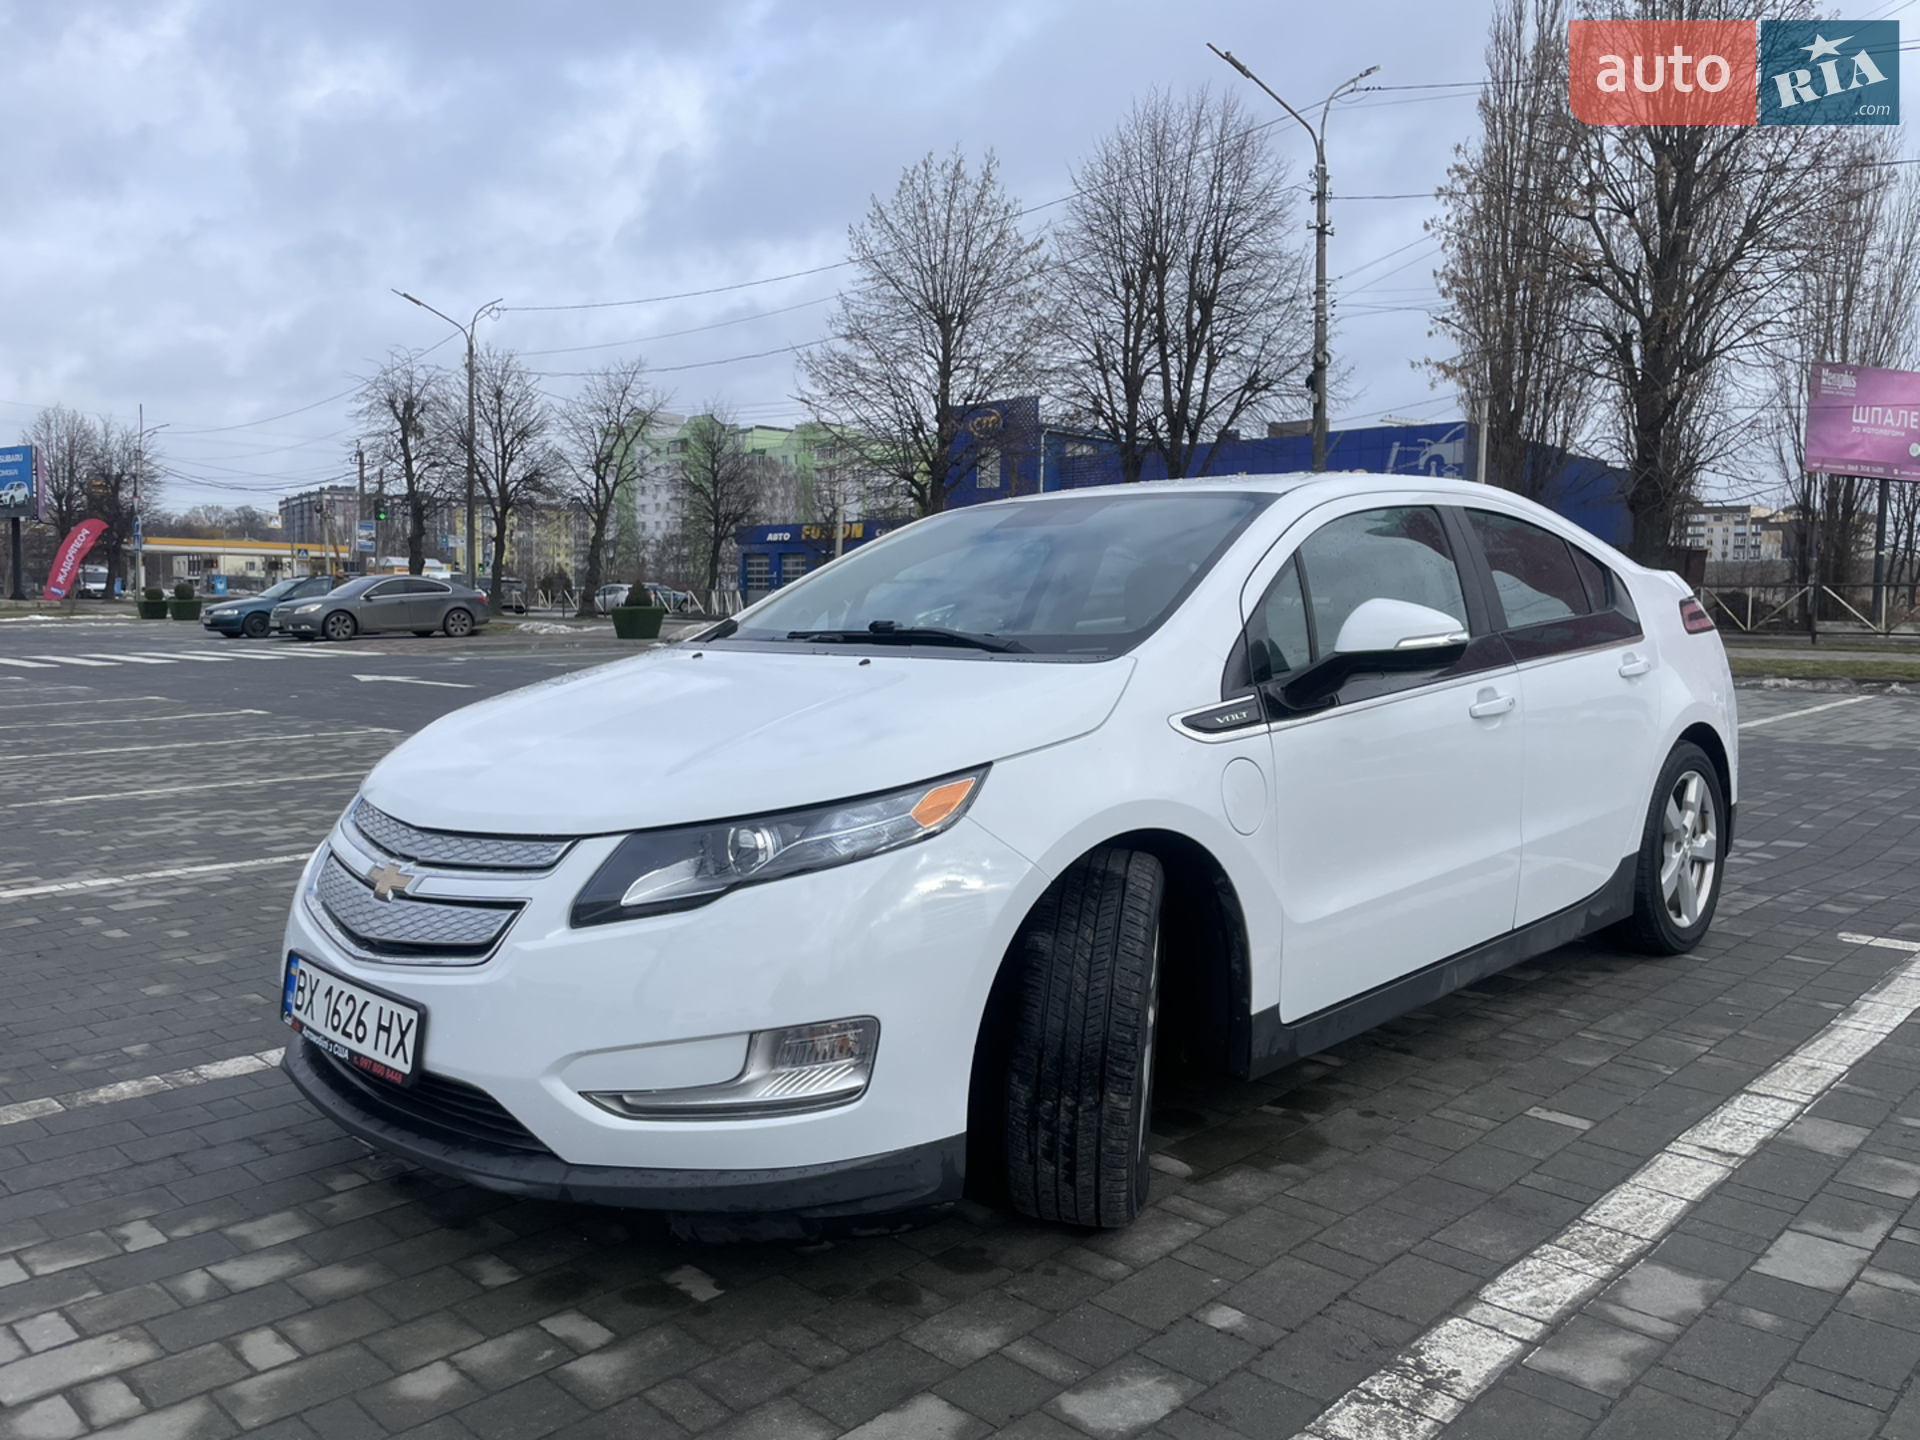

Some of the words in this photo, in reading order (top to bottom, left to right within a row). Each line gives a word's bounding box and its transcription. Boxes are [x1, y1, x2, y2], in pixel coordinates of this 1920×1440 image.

[1852, 404, 1919, 429] ШПАЛЕ
[766, 532, 791, 541] АВТО
[294, 968, 320, 1021] BX
[324, 985, 370, 1044] 1626
[374, 1006, 414, 1065] HX
